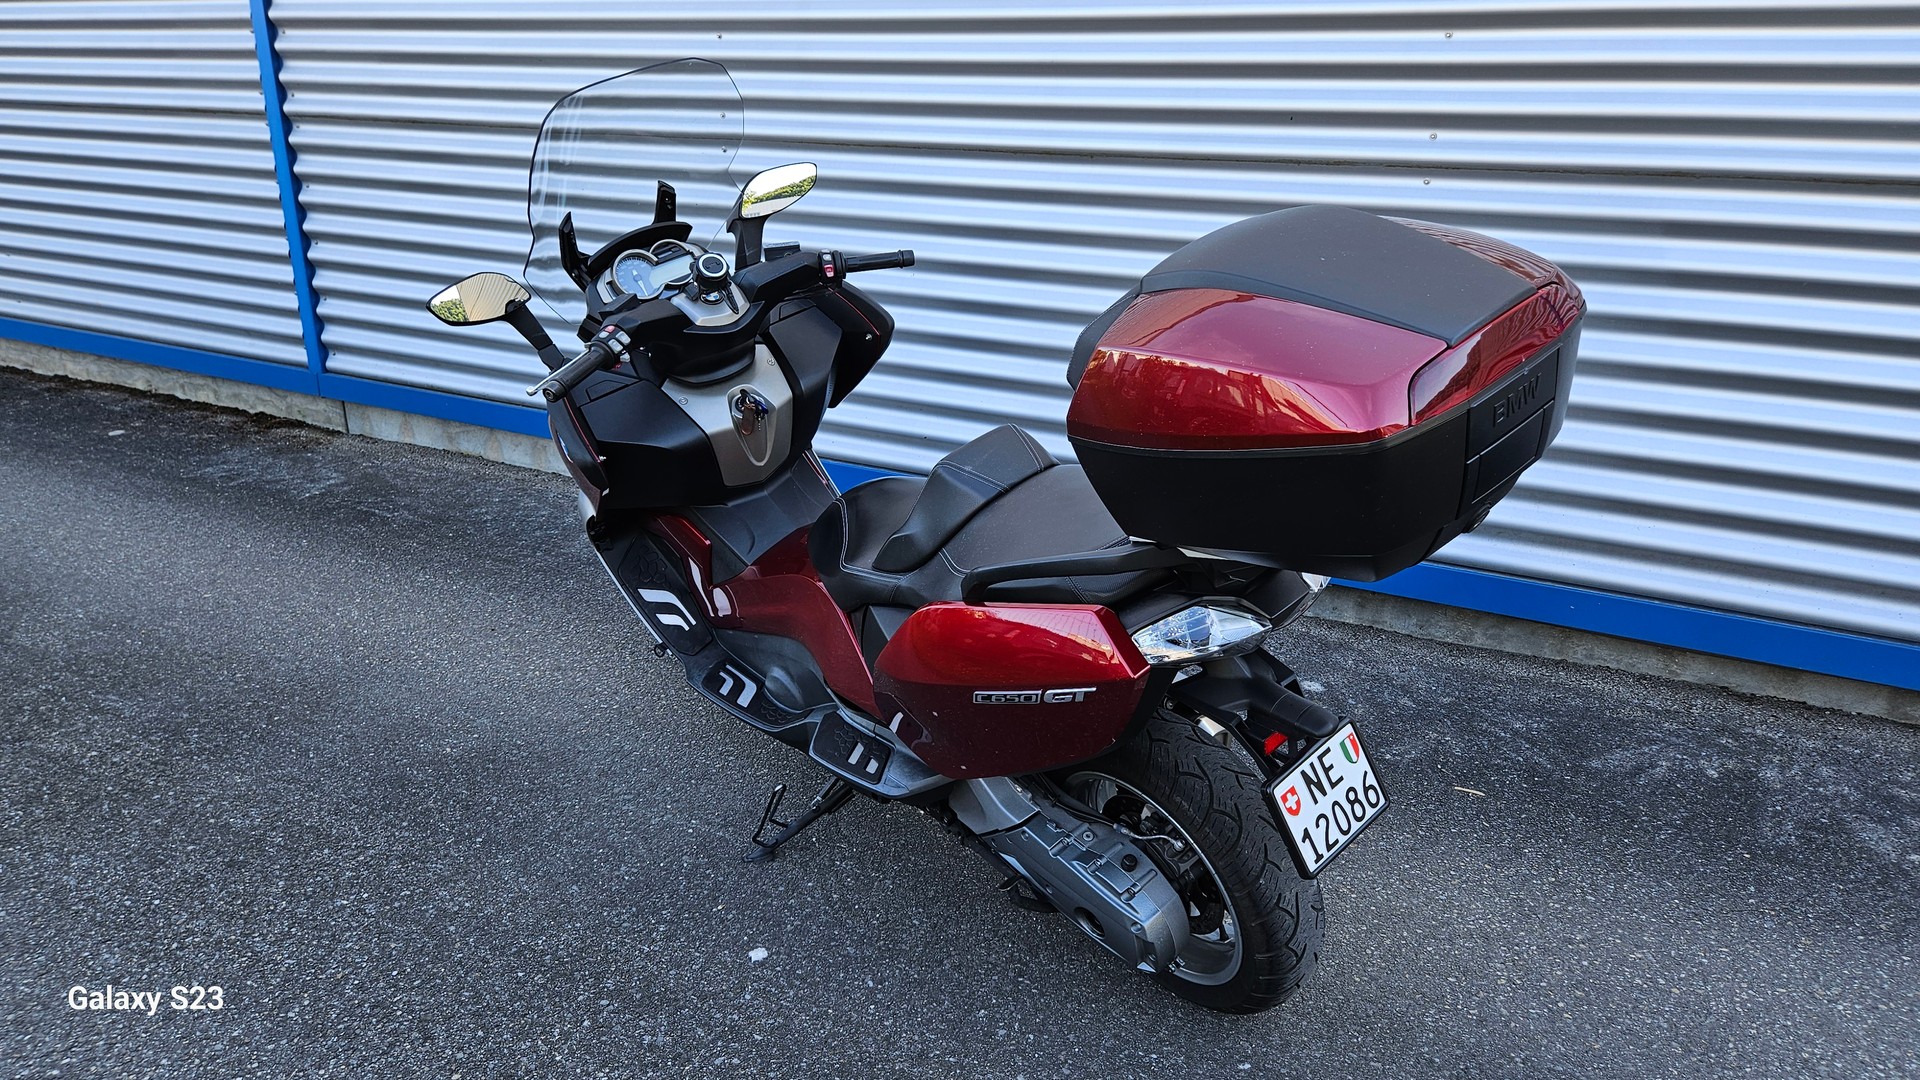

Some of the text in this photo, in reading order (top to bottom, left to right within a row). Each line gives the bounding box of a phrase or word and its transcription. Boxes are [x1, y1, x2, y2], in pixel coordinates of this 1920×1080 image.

[1493, 373, 1542, 427] BMW
[975, 687, 1097, 704] C650 GT
[1300, 746, 1344, 805] NE
[1301, 770, 1381, 865] 12086
